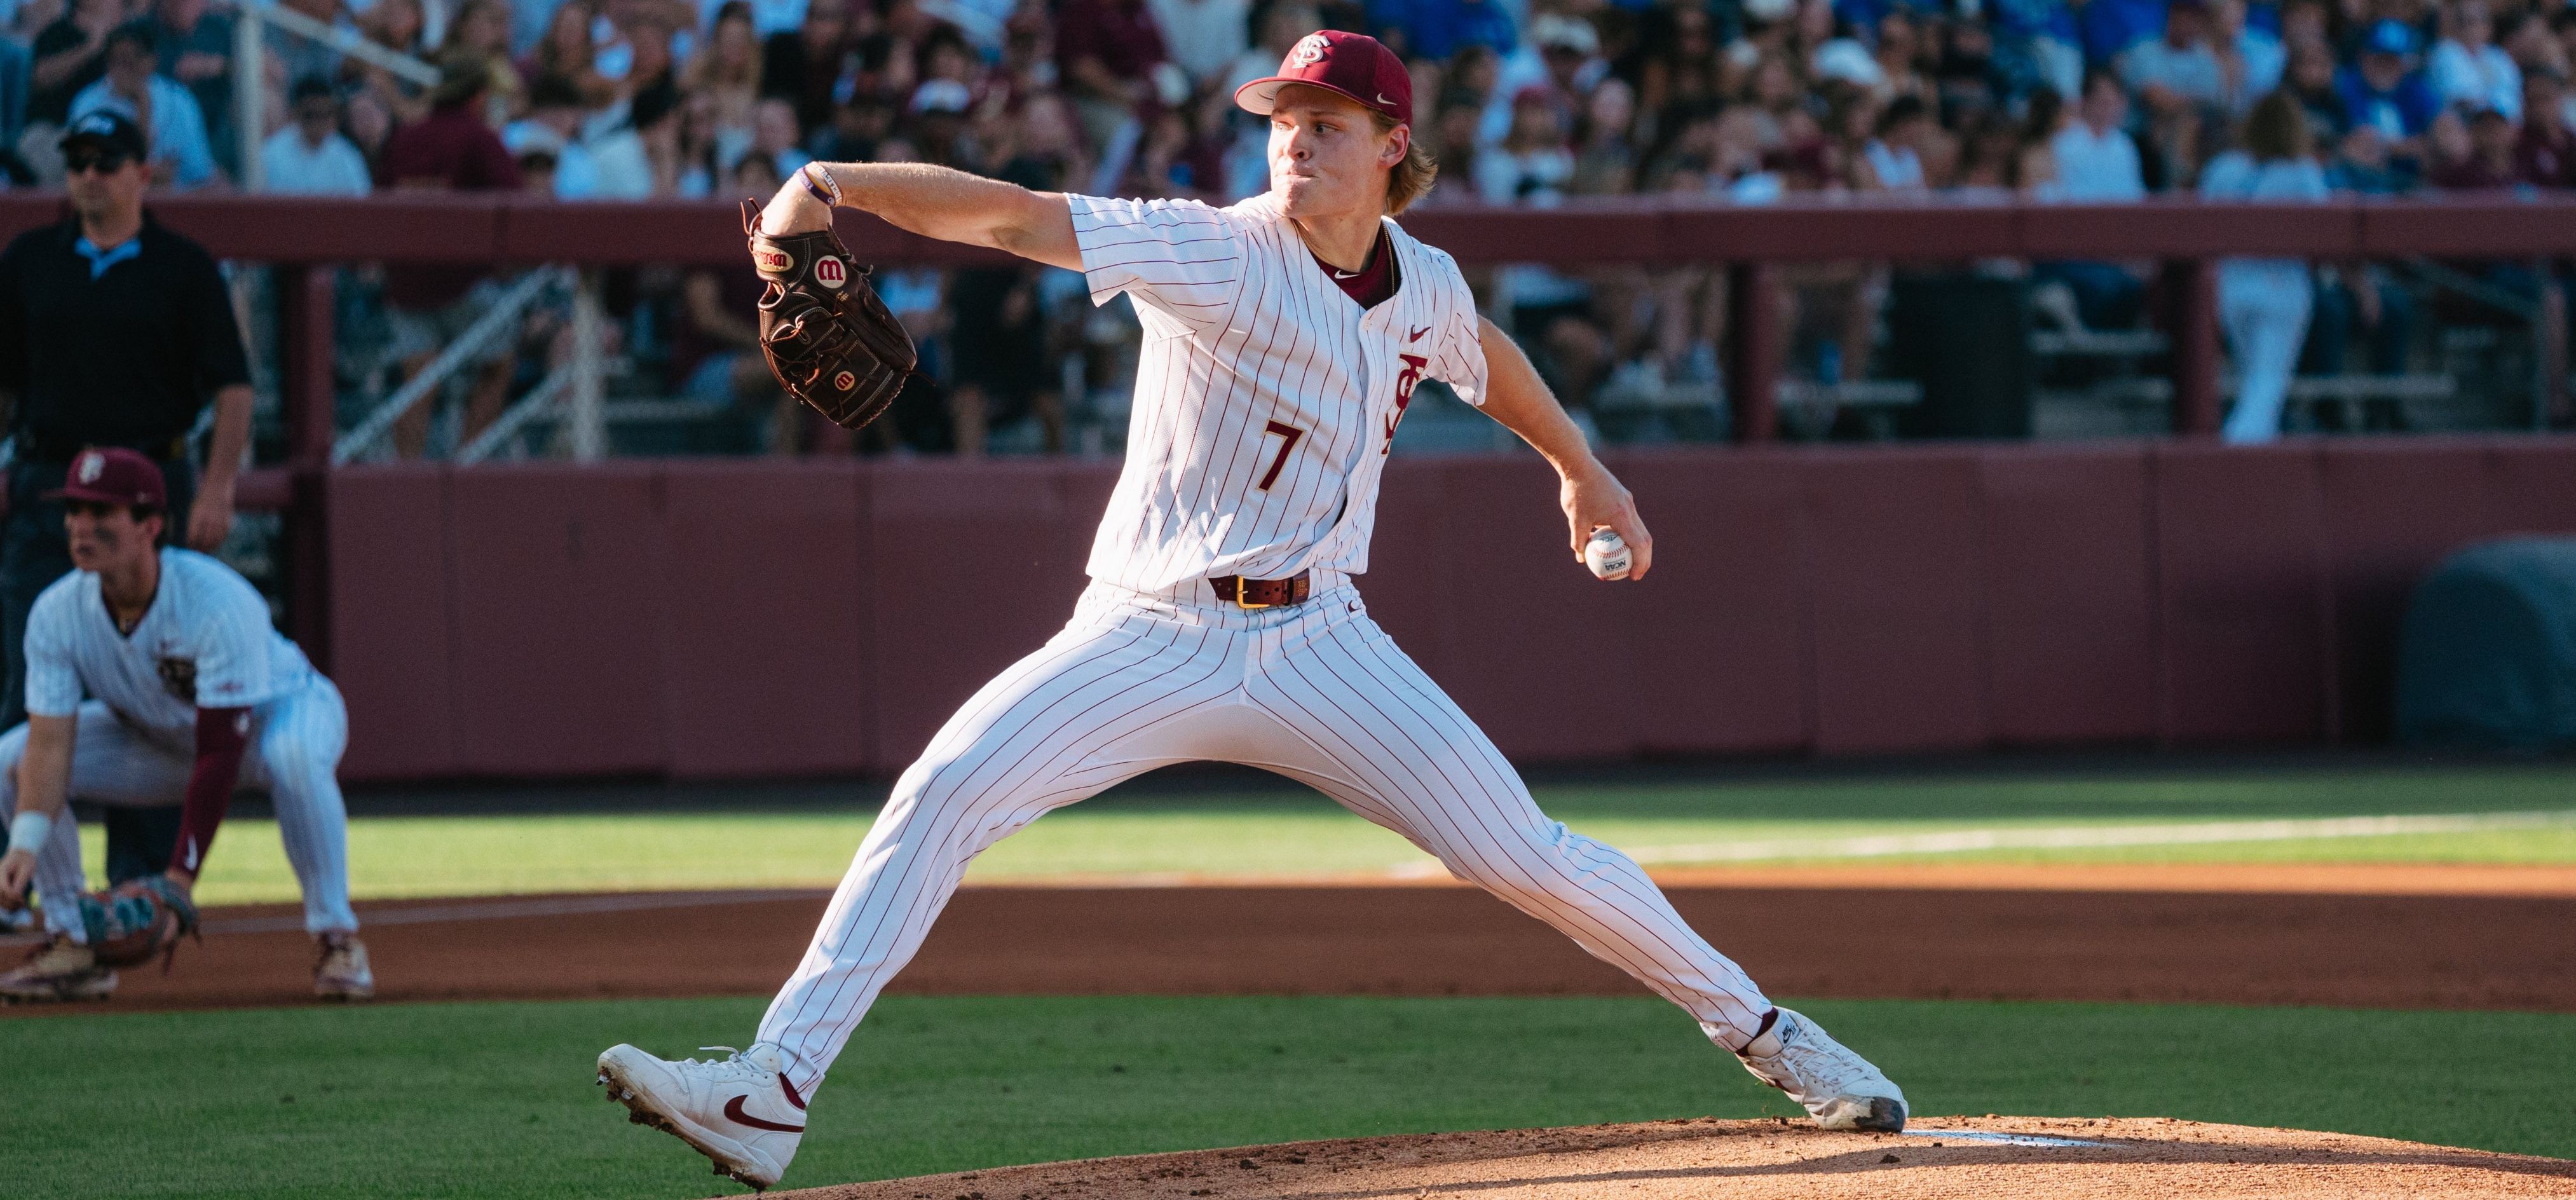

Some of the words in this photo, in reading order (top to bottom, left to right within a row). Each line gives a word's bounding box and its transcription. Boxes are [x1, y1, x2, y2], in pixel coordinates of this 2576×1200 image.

[754, 250, 787, 267] Wil
[817, 259, 843, 281] W
[1255, 418, 1307, 494] 7
[1605, 559, 1626, 571] NCAA
